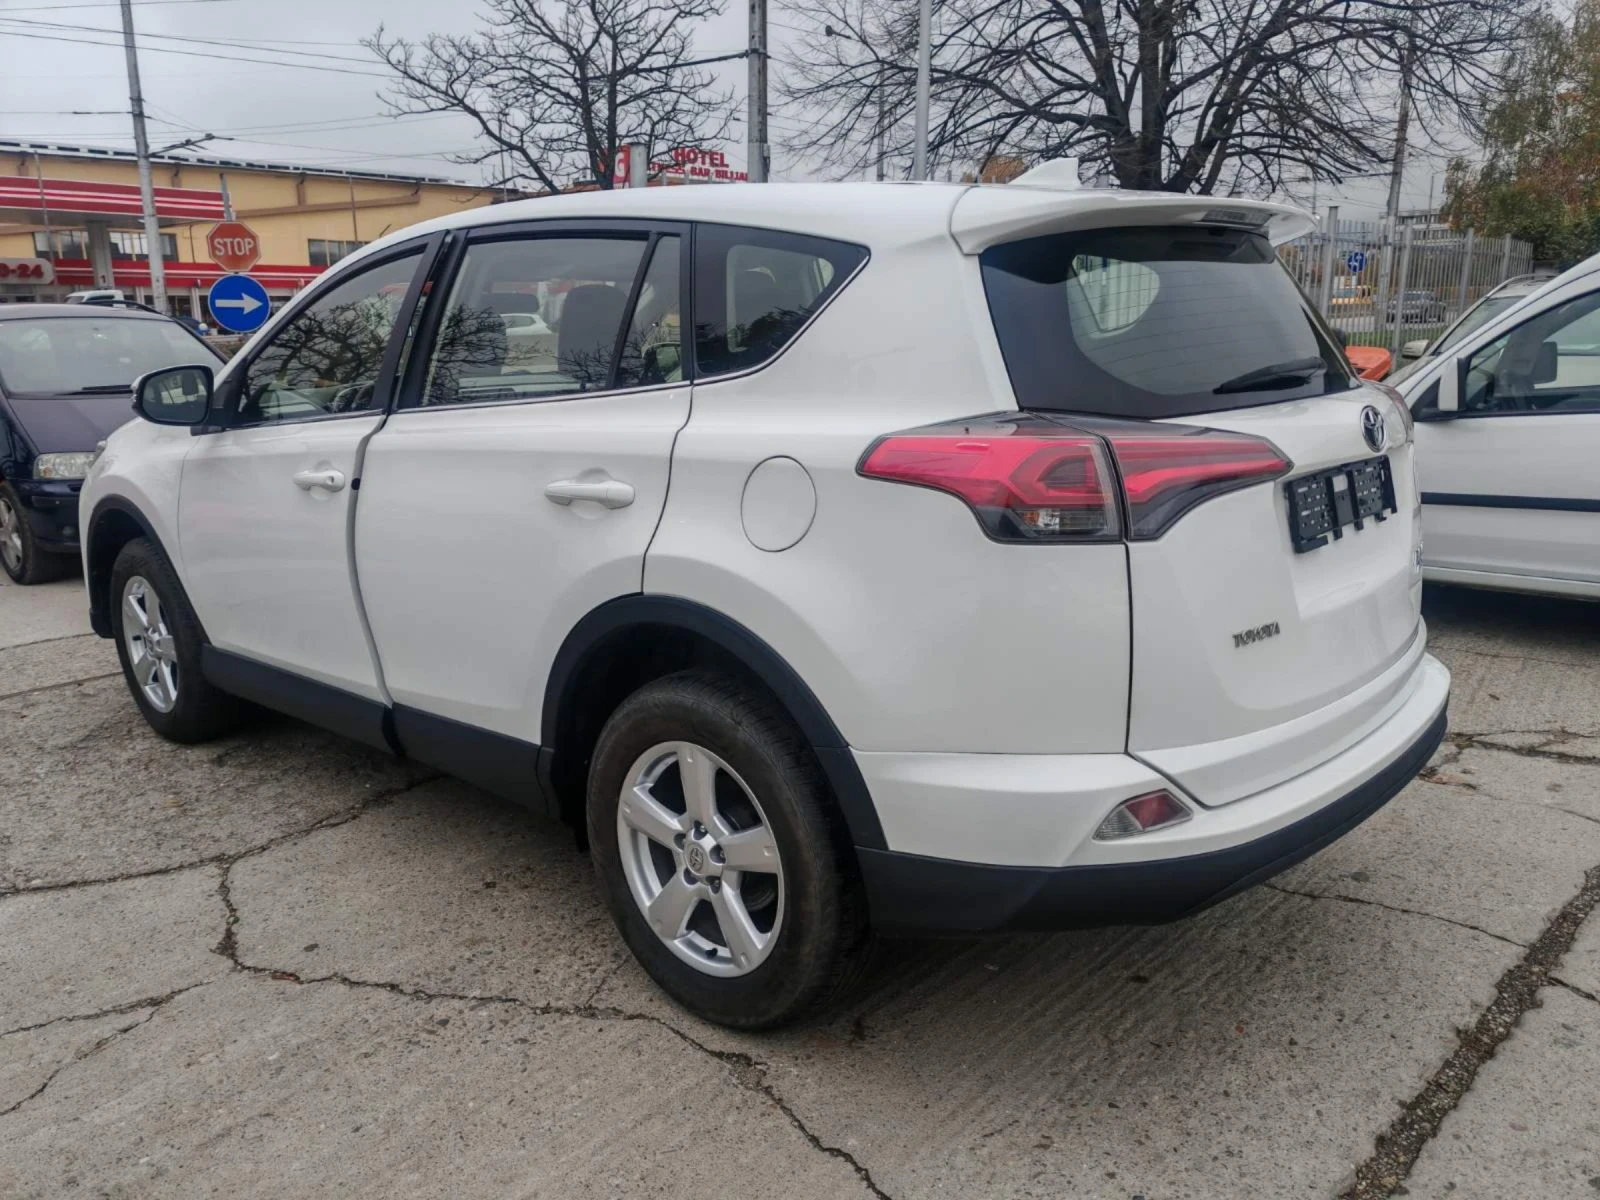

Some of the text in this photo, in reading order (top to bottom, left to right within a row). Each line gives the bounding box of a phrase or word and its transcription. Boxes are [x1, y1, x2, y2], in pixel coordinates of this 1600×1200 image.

[673, 147, 729, 168] HOTEL
[214, 238, 254, 256] STOP
[1232, 621, 1280, 648] TOYOTA
